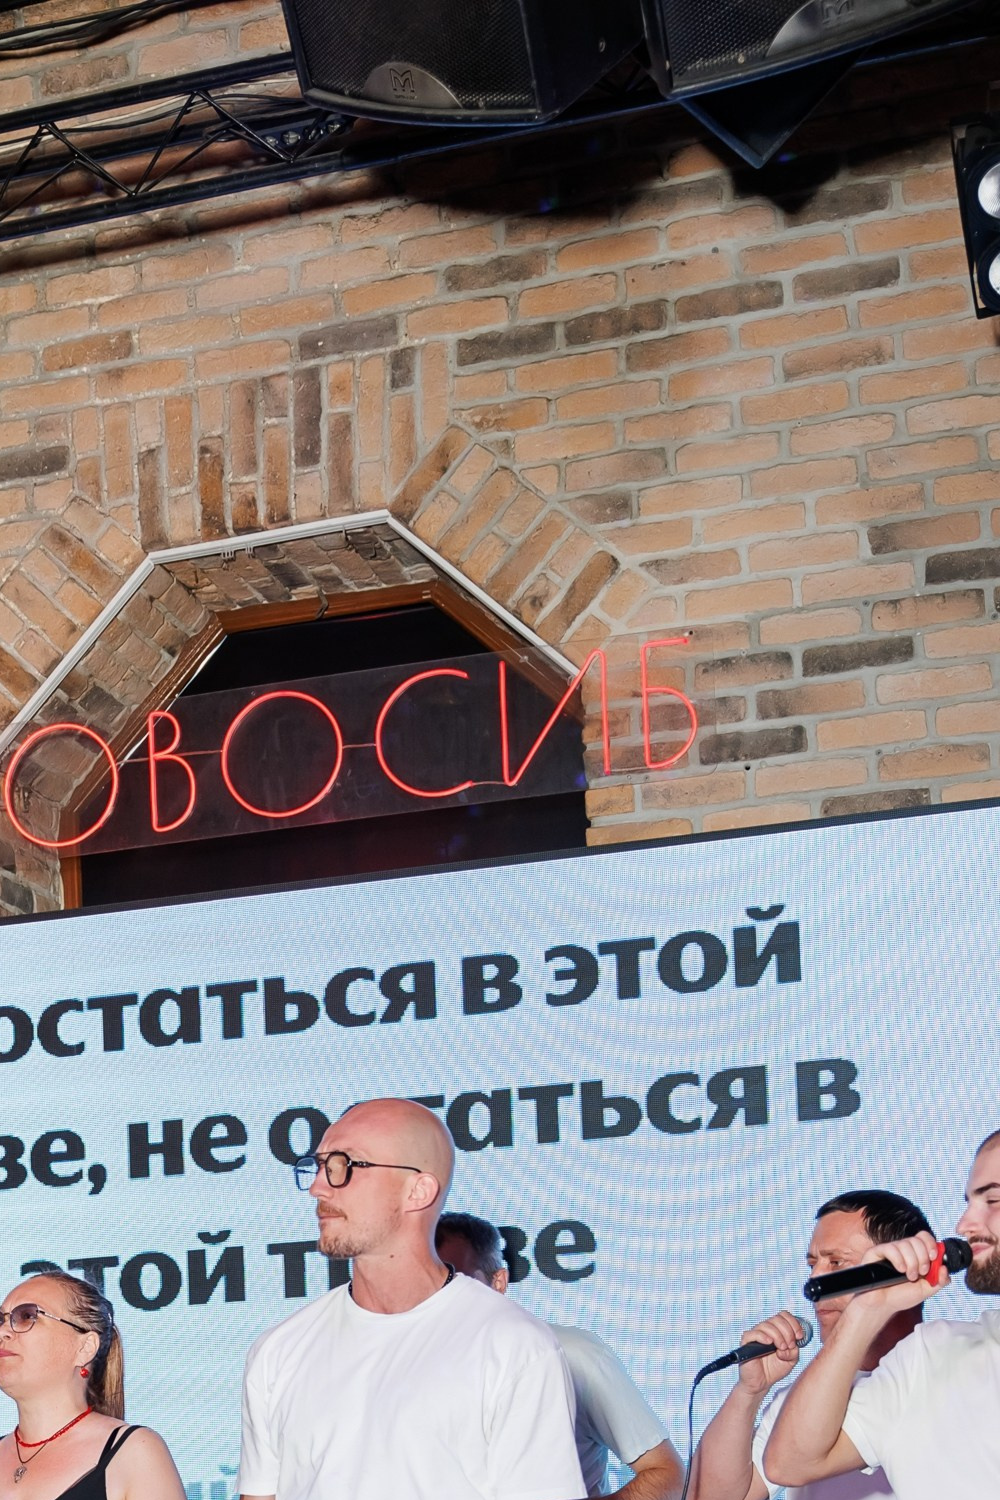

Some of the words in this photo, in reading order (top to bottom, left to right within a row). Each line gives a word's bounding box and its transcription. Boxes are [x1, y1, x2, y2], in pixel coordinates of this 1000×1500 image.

[461, 953, 523, 1016] в
[544, 904, 802, 1008] этой
[128, 1112, 248, 1179] не
[268, 1064, 770, 1167] оаться
[795, 1057, 861, 1122] в
[20, 1229, 246, 1312] той
